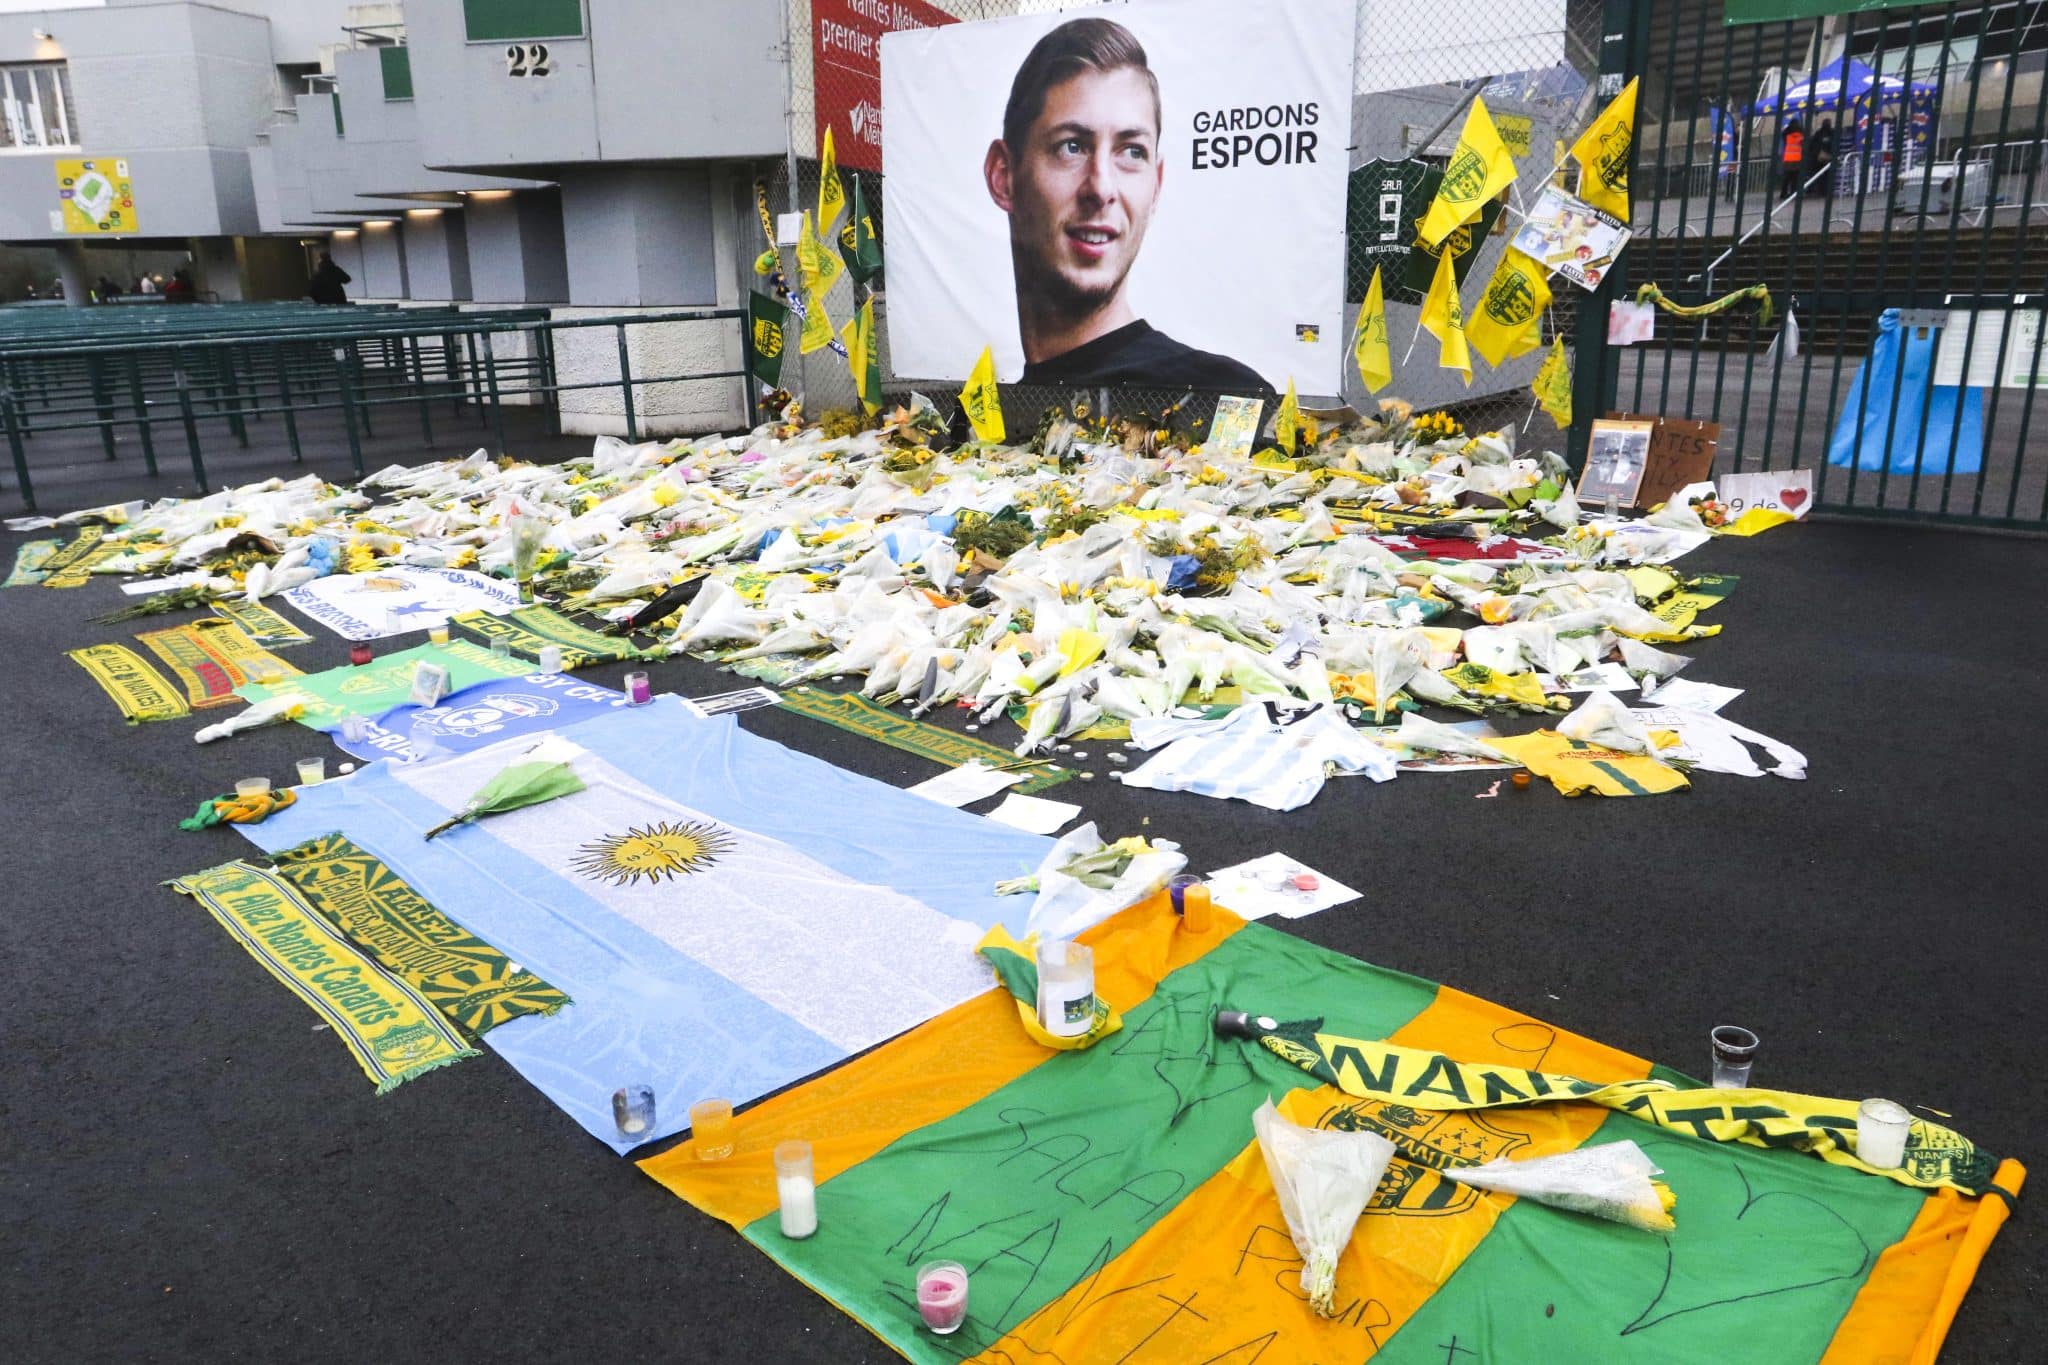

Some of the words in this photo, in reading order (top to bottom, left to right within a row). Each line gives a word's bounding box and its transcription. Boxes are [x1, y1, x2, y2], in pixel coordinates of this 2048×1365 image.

[821, 18, 873, 59] premier
[507, 44, 550, 77] 22
[1193, 102, 1320, 134] GARDONS
[1191, 130, 1317, 170] ESPOIR
[1381, 179, 1402, 191] SALA
[1379, 193, 1403, 241] 9
[227, 893, 285, 927] Allez
[256, 919, 336, 971] Nantes
[310, 965, 404, 1026] Canaris
[1382, 1128, 1476, 1170] NANTE
[1914, 1149, 1965, 1160] NANTES
